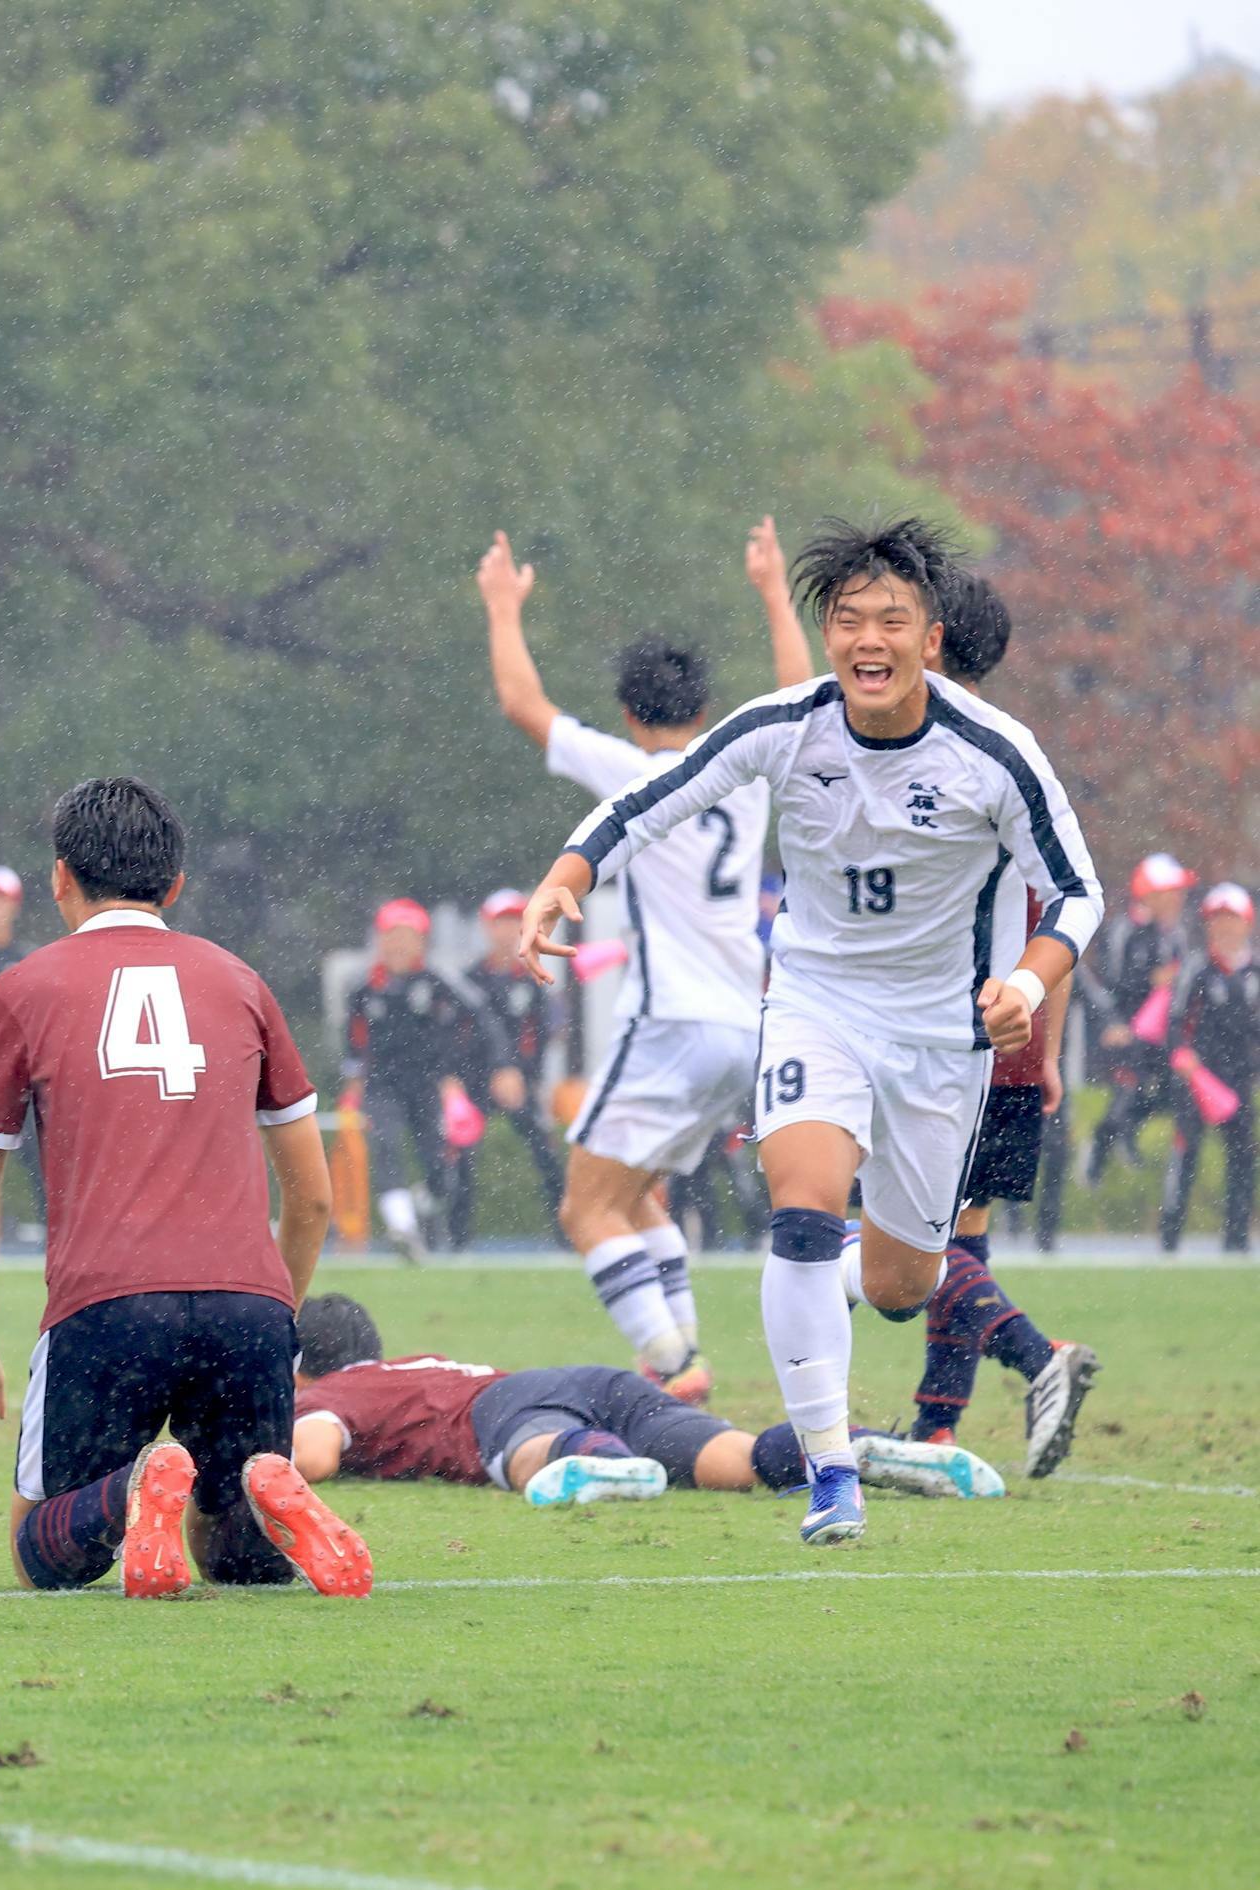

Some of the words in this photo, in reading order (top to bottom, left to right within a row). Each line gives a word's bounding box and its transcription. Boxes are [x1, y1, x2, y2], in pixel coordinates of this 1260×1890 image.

[697, 805, 742, 900] 2
[843, 864, 896, 915] 19
[97, 965, 207, 1101] 4
[761, 1056, 806, 1116] 19
